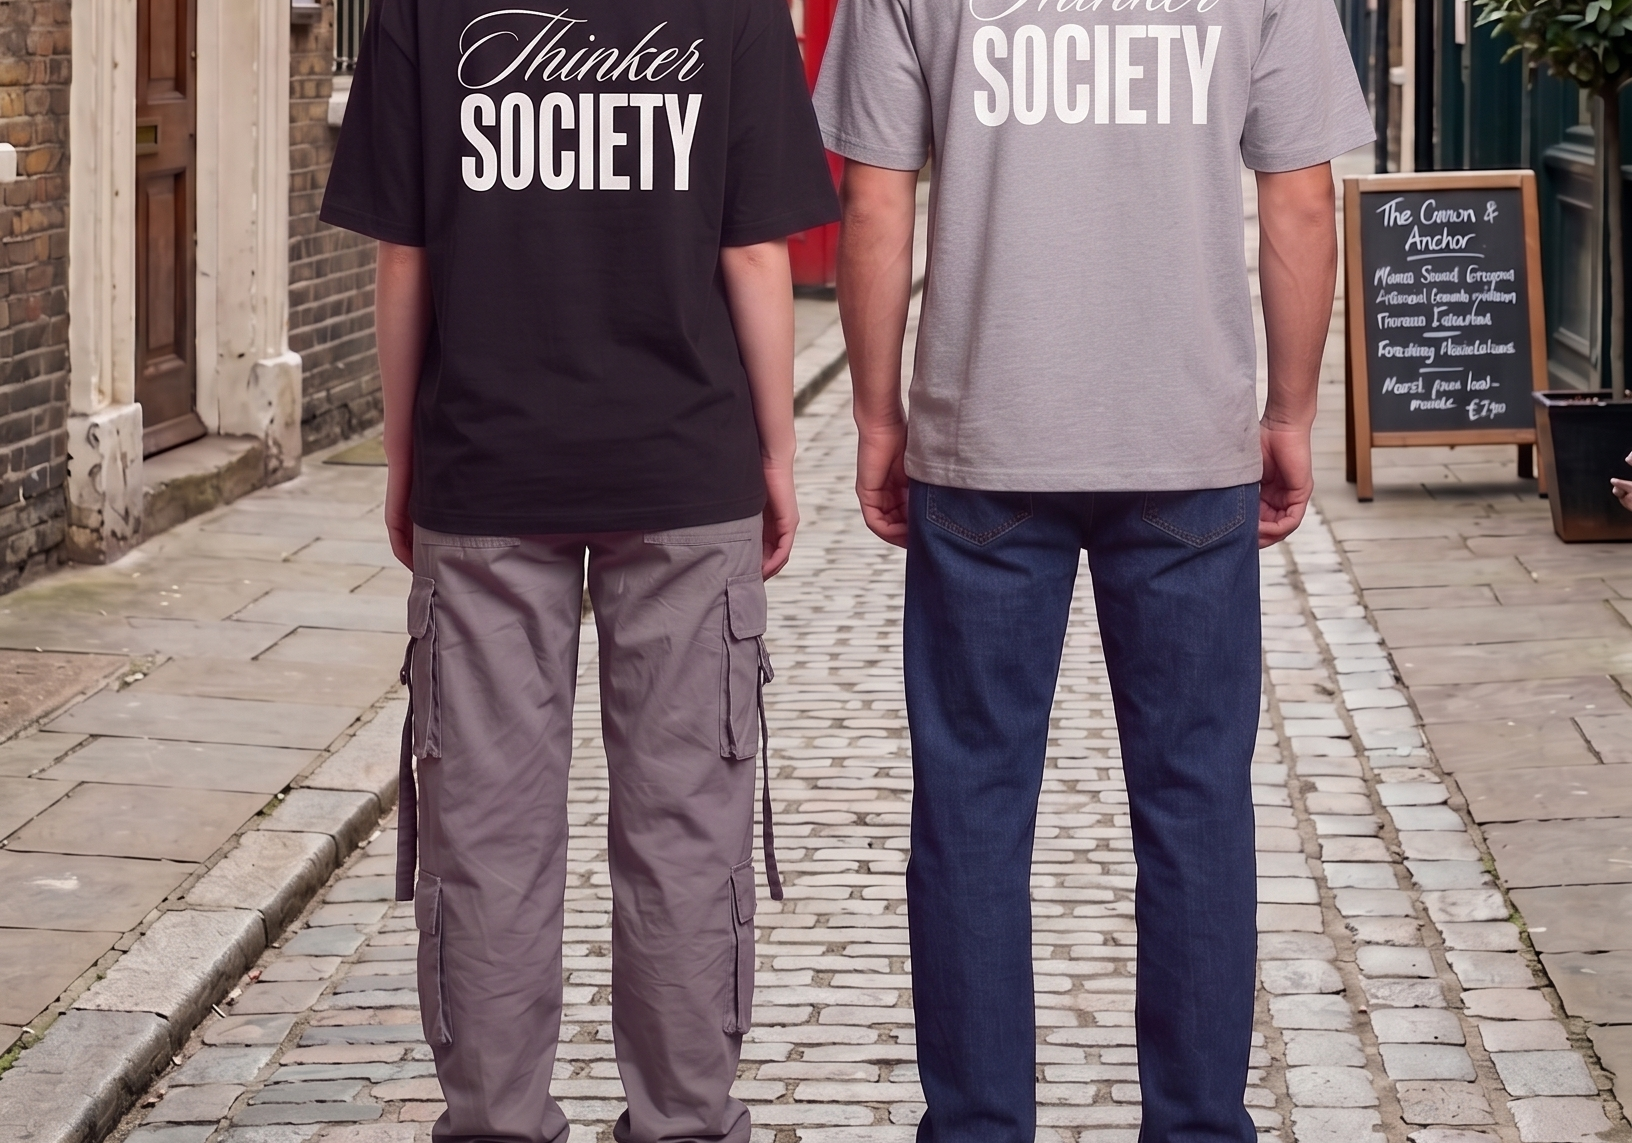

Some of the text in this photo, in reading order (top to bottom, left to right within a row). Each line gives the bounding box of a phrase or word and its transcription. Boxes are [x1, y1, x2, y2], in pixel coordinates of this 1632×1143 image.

[457, 8, 704, 89] Thinker
[973, 24, 1222, 127] SOCIETY
[460, 92, 702, 191] SOCIETY
[1376, 197, 1413, 227] The
[1405, 225, 1476, 251] Anchor
